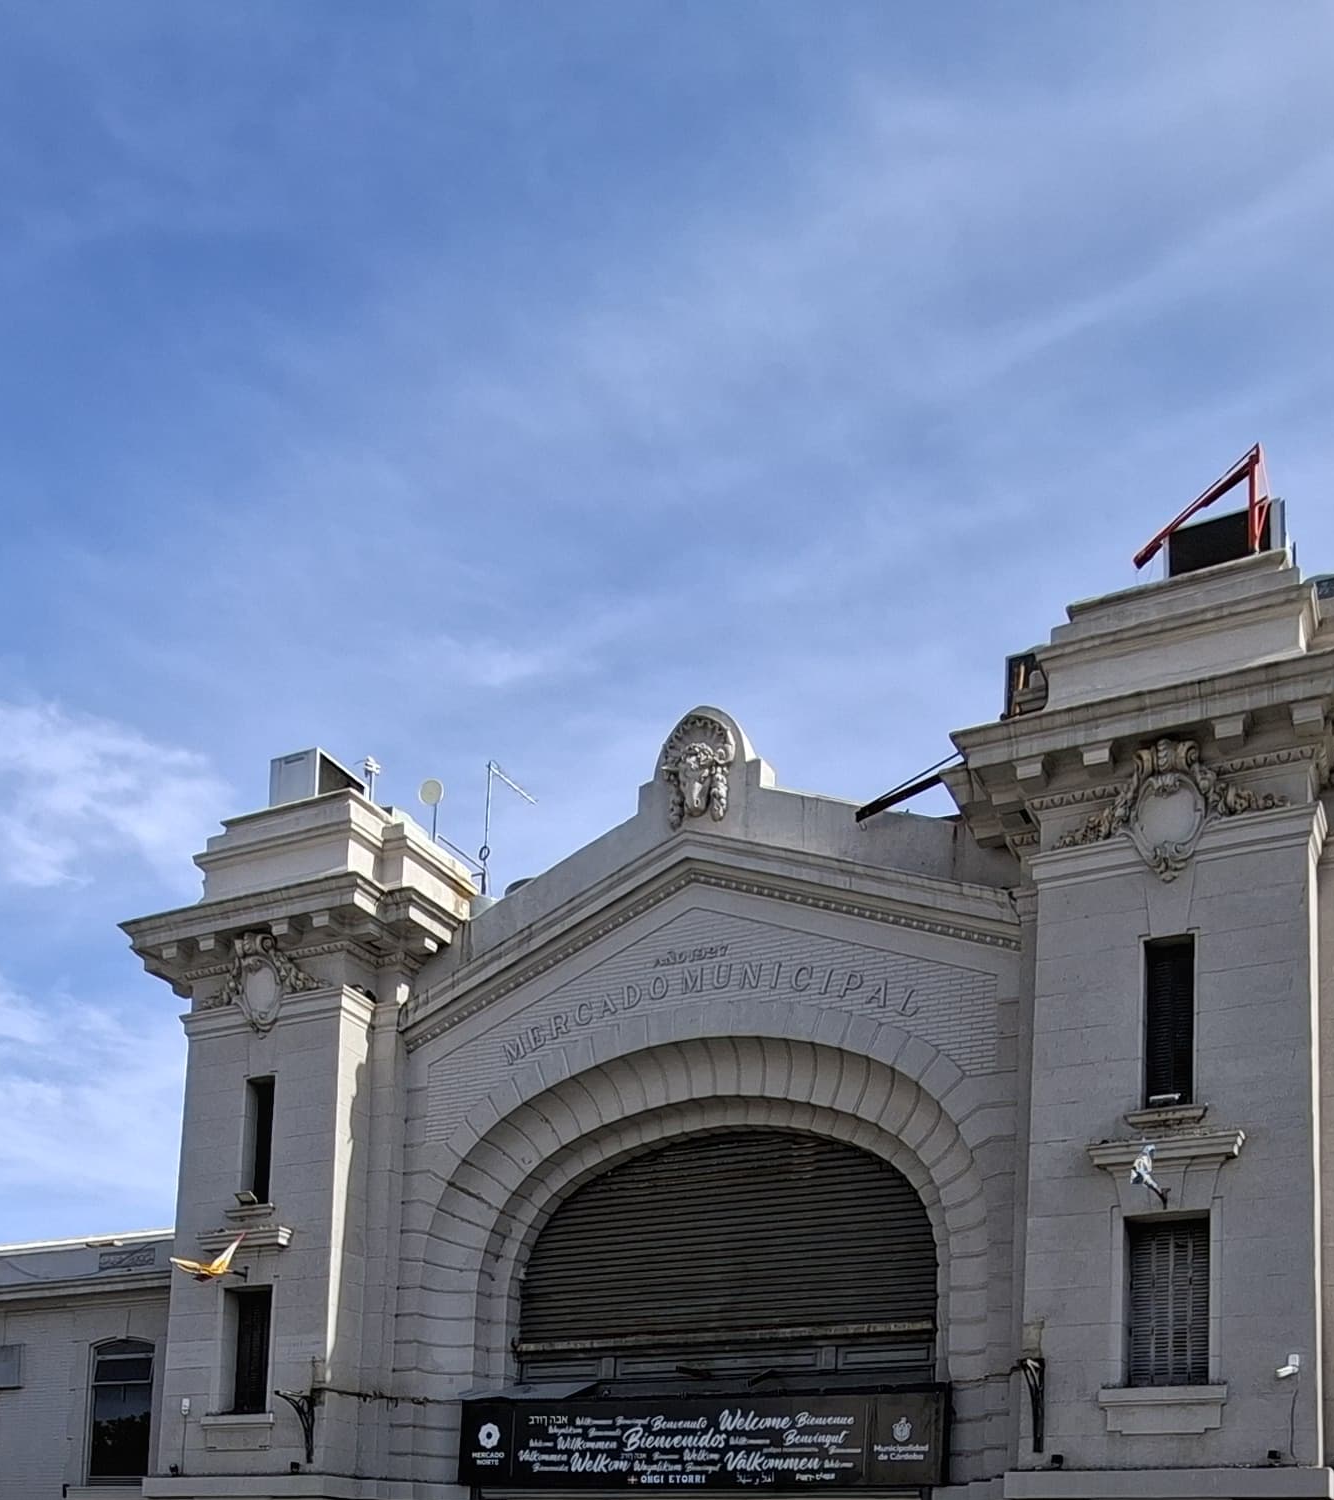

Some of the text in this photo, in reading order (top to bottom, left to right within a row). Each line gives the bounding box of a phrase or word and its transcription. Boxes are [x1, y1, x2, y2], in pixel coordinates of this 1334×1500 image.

[503, 961, 921, 1066] MERCADO MUNICIPAL
[651, 1415, 707, 1431] Benvenuto
[719, 1408, 792, 1431] Welcome
[795, 1411, 854, 1428] Bienvenue
[556, 1436, 617, 1451] Willkommen
[622, 1427, 726, 1452] Bienvenidos
[783, 1429, 851, 1448] Benvingut
[873, 1444, 929, 1453] Municipalidad
[890, 1453, 924, 1461] Córdoba
[570, 1452, 631, 1473] Welkom
[668, 1475, 705, 1484] ETORRI
